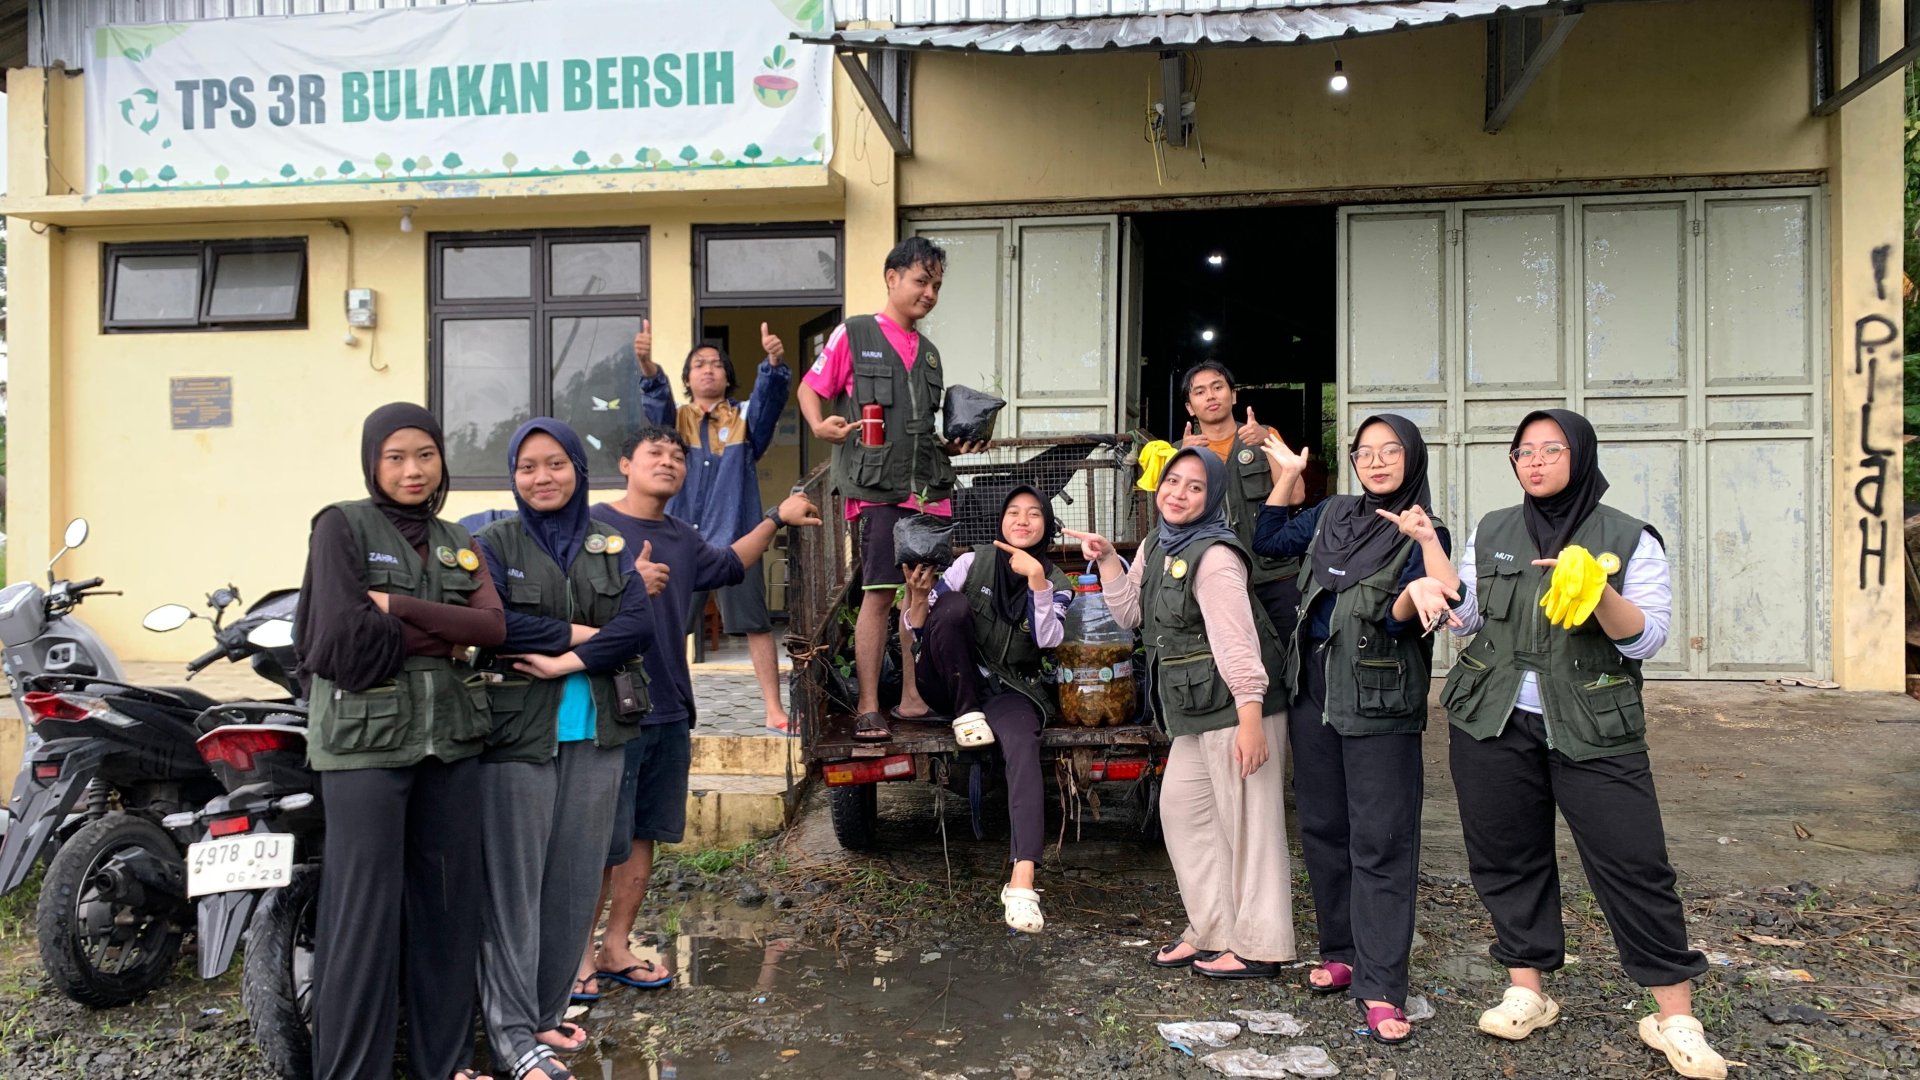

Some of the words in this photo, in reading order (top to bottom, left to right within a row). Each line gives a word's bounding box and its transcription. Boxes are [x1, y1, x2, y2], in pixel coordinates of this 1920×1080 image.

[175, 76, 257, 130] TPS
[268, 74, 326, 127] 3R
[342, 61, 548, 123] BULAKAN
[563, 51, 735, 112] BERSIH
[368, 552, 399, 565] ZAHRA
[1494, 551, 1515, 562] MUTI
[195, 843, 240, 867] 4978
